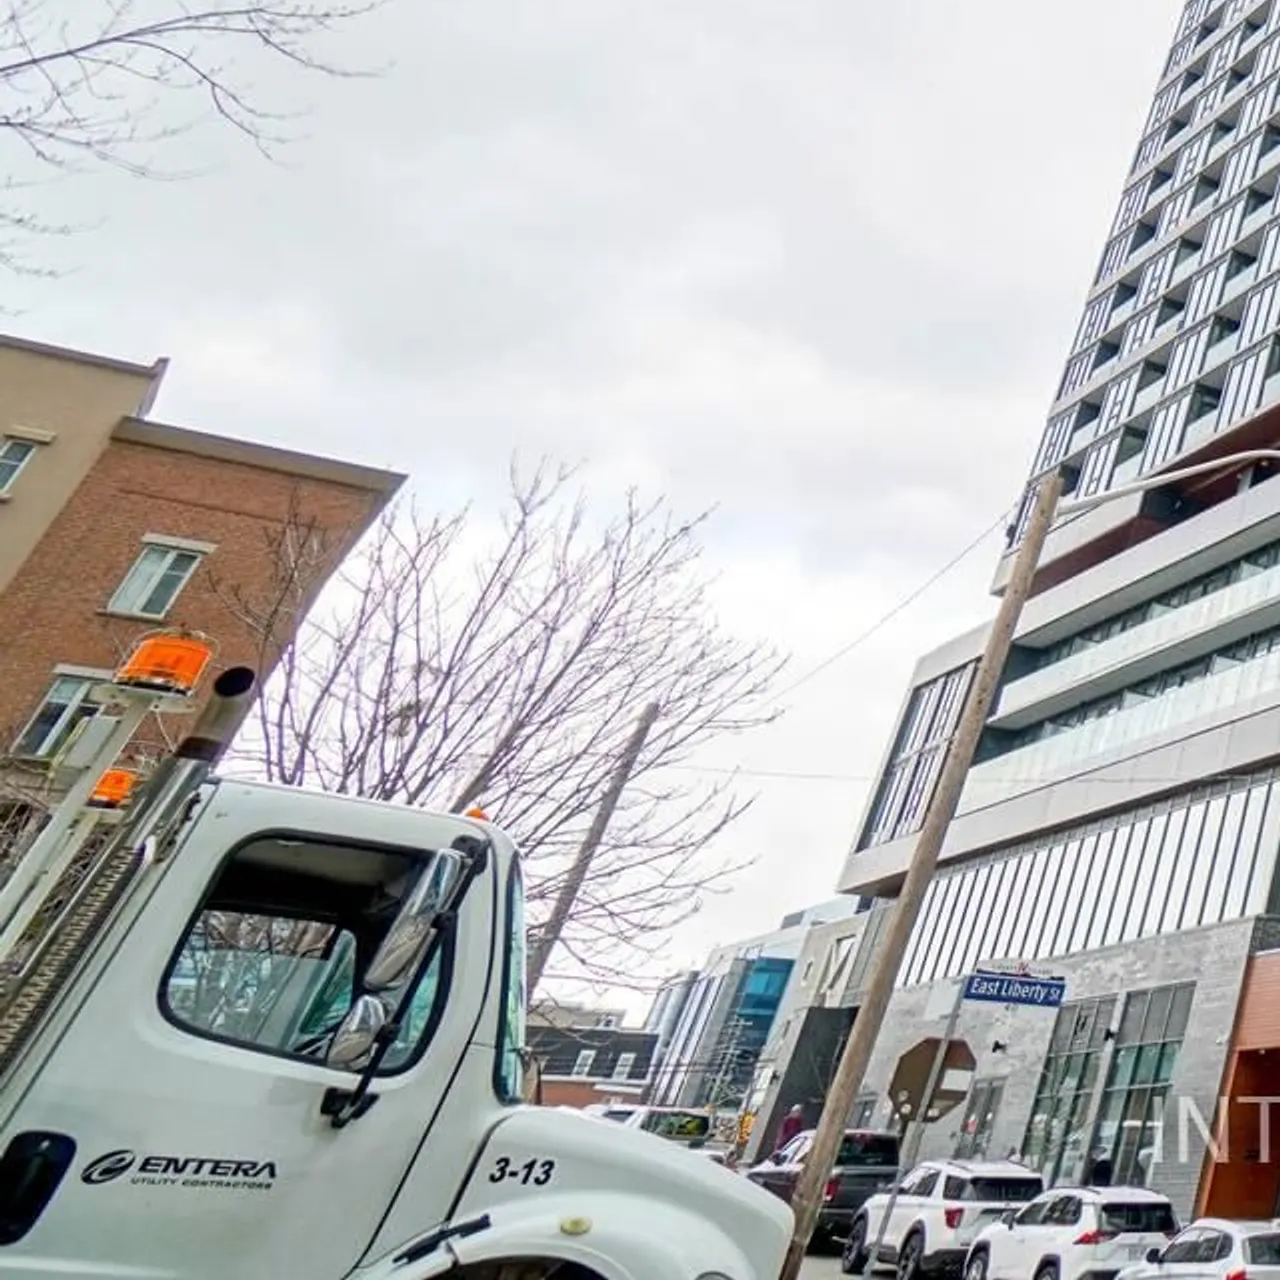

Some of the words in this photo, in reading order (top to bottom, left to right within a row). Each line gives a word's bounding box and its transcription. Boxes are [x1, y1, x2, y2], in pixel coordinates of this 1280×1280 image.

[970, 978, 999, 996] East
[1001, 980, 1048, 1003] Liberty
[138, 1156, 277, 1178] ENTERA
[489, 1156, 555, 1186] 3-13
[131, 1177, 178, 1186] UTILITY
[182, 1181, 273, 1190] CONTRACTORS
